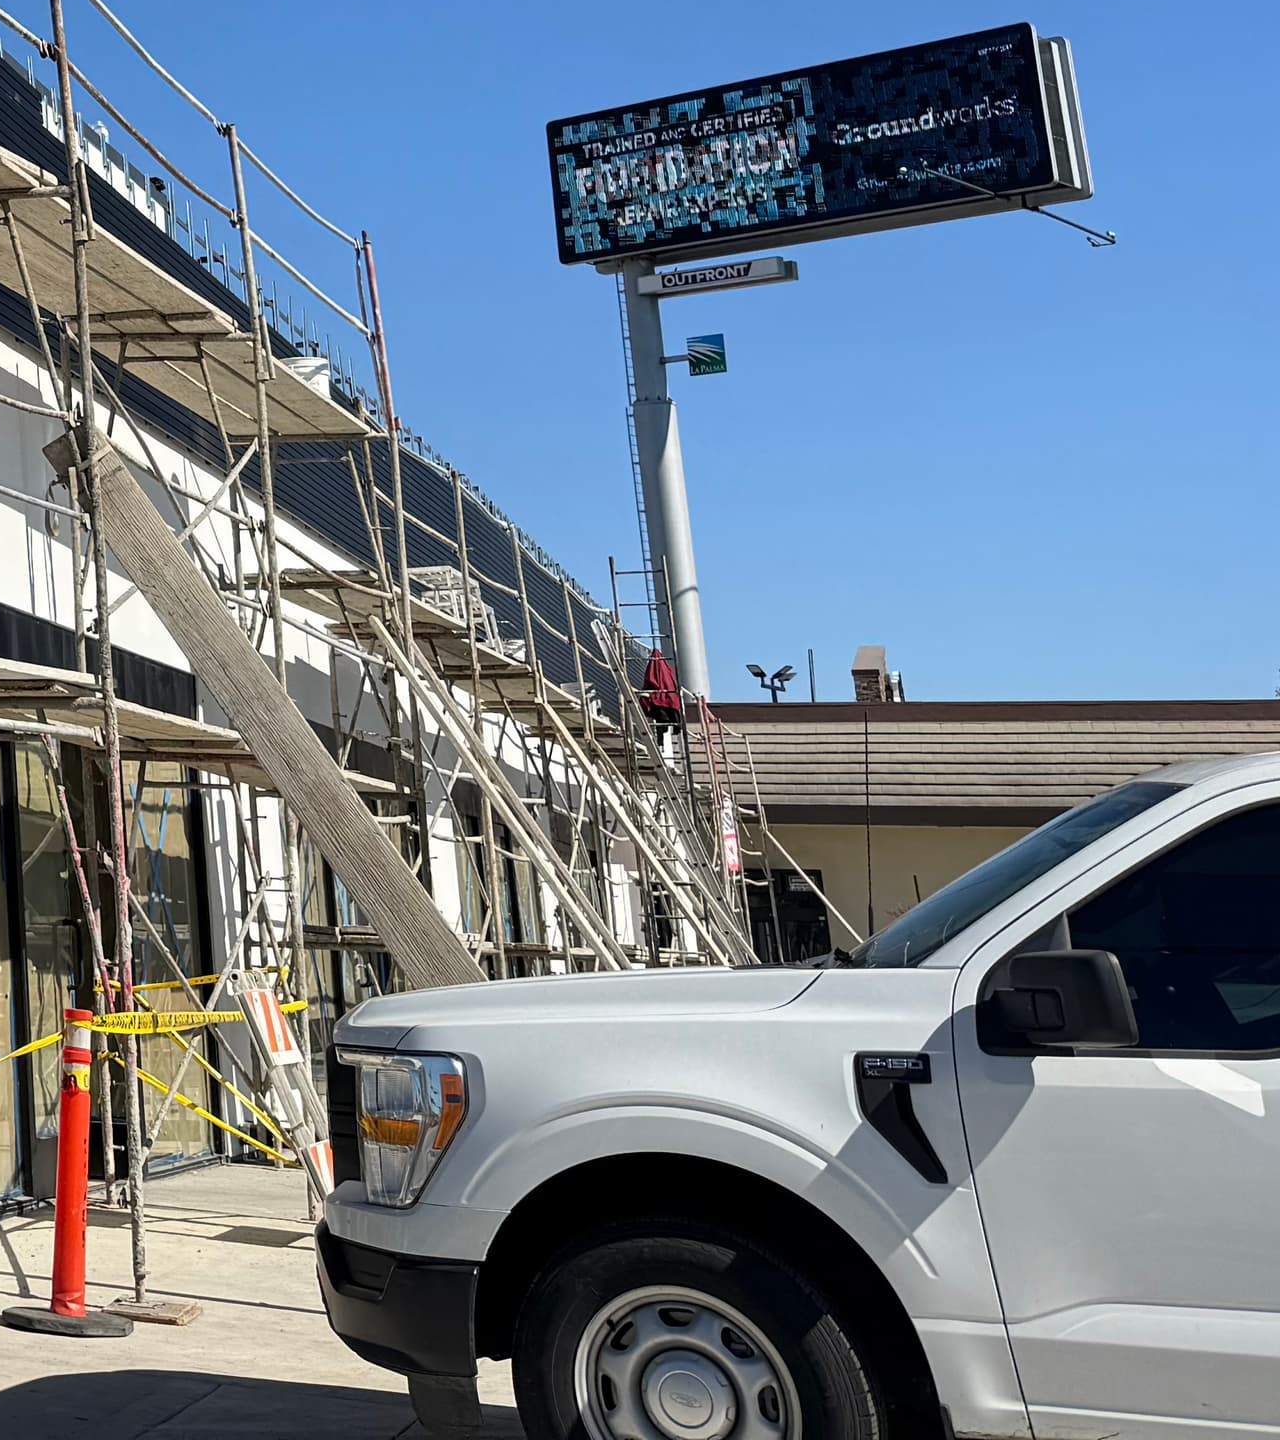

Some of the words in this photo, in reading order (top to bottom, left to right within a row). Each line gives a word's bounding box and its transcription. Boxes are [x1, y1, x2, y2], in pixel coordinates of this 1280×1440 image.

[583, 131, 656, 159] TRAINED
[691, 107, 784, 137] CERTIFIED
[664, 265, 748, 286] OUTFRONT
[864, 1058, 923, 1070] F-150
